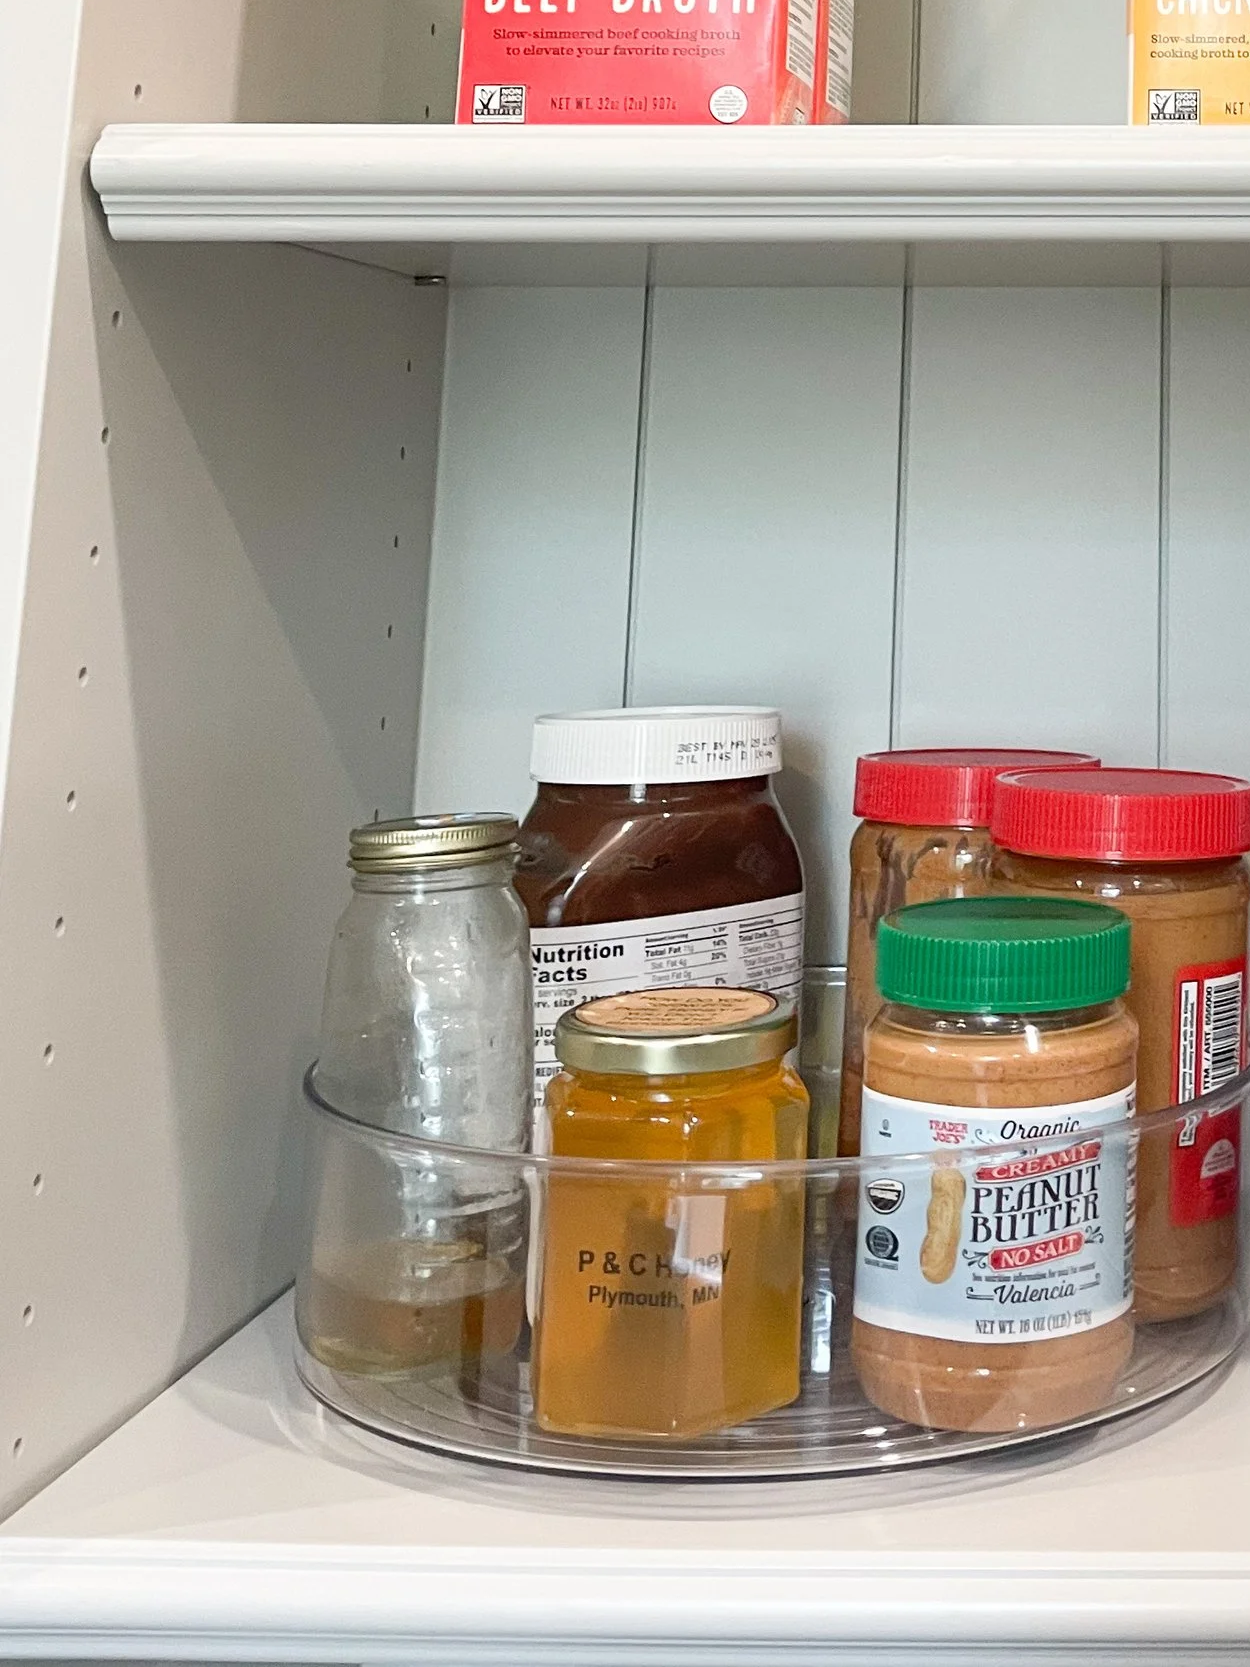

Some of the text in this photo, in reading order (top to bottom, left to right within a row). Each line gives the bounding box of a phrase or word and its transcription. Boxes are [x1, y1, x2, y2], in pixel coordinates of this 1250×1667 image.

[493, 28, 741, 42] Slow-simmered beef cooking broth
[1151, 33, 1249, 45] Slow-simmered,
[506, 45, 726, 58] to elevate your favorite recipes
[1150, 48, 1199, 61] cooking
[1200, 48, 1236, 59] broth
[1237, 49, 1250, 59] to
[550, 97, 570, 110] NET
[1225, 102, 1244, 115] NET
[532, 943, 624, 964] Nutrition
[645, 946, 681, 958] Total Fat
[538, 987, 578, 998] servings
[554, 998, 575, 1007] size
[929, 1118, 968, 1134] TRADER
[991, 1146, 1087, 1179] CREAMY
[971, 1163, 1101, 1215] PEANUT
[969, 1192, 1100, 1243] BUTTER
[1000, 1234, 1079, 1269] NO SALT
[578, 1248, 731, 1279] P & C Honey
[588, 1285, 719, 1310] Plymouth, MN
[993, 1280, 1077, 1305] Valencia
[975, 1319, 995, 1335] NET
[998, 1319, 1016, 1335] WT.
[1033, 1316, 1046, 1332] OZ
